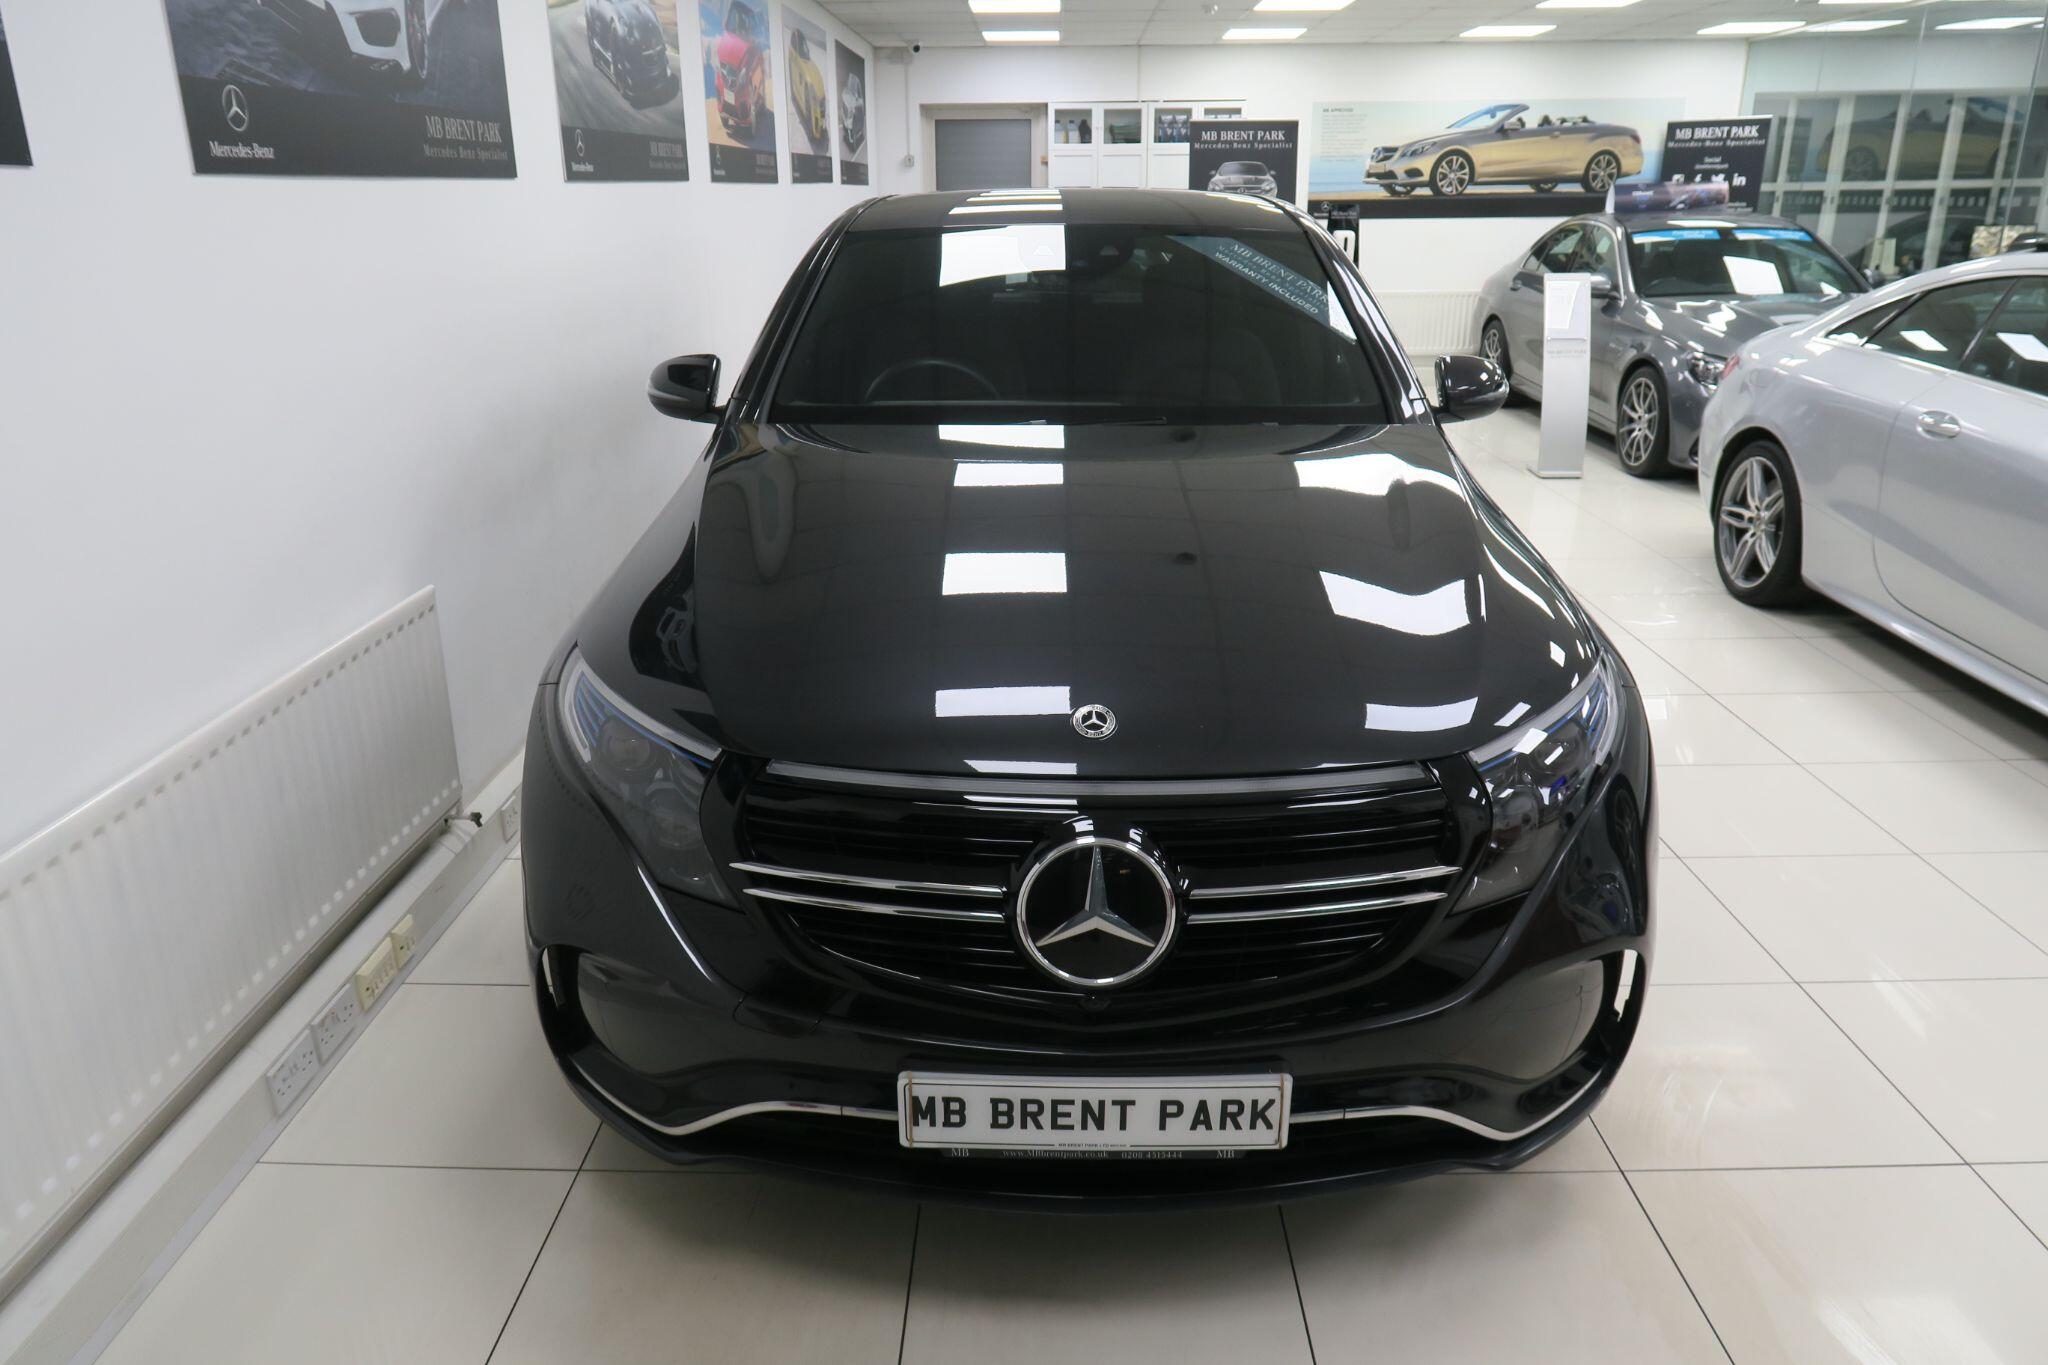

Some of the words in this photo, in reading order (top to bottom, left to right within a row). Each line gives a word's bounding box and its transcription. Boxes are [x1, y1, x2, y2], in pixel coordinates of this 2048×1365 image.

[425, 114, 443, 138] MB
[443, 117, 475, 140] BRENT
[477, 120, 502, 143] PARK
[1201, 130, 1218, 141] MB
[1220, 130, 1254, 141] BRENT
[1257, 130, 1286, 141] PARK
[1675, 128, 1692, 140] MB
[1693, 126, 1730, 140] BRENT
[1730, 125, 1760, 138] PARK
[208, 140, 275, 159] Mercedes-Benz
[1254, 142, 1293, 150] Specialist
[1230, 244, 1253, 258] MB
[1252, 256, 1298, 281] BRENT
[1296, 280, 1329, 303] PARK
[1215, 252, 1269, 283] WARRANTY
[1268, 282, 1319, 313] INCLUDED
[912, 1095, 967, 1128] MB
[989, 1097, 1137, 1131] BRENT
[1158, 1098, 1276, 1131] PARK
[951, 1148, 969, 1158] MB
[1216, 1148, 1235, 1159] MB
